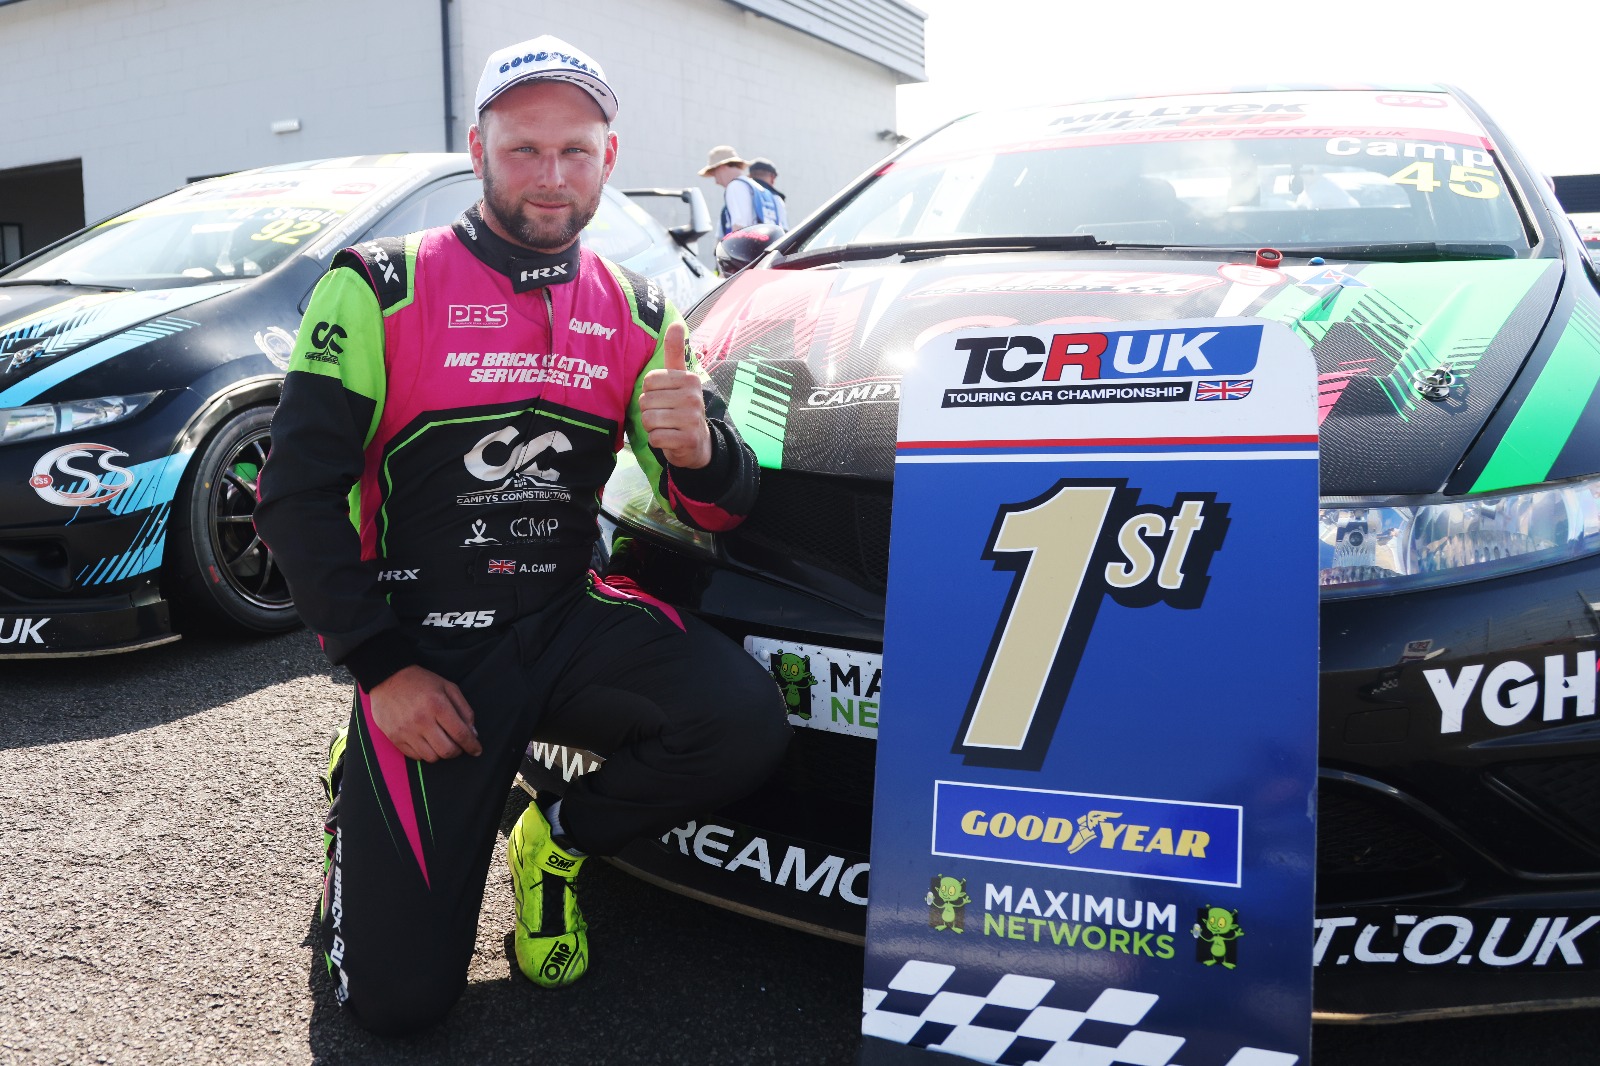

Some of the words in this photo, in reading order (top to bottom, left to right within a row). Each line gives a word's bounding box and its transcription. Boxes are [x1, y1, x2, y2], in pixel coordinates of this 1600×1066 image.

[1325, 137, 1494, 168] Camp
[1387, 161, 1500, 199] 45
[250, 218, 321, 245] 92
[520, 262, 568, 283] HRX
[569, 317, 617, 341] CAMPY
[444, 353, 480, 367] MC
[482, 353, 540, 367] BRICK
[955, 332, 1109, 384] TCR
[1113, 331, 1214, 374] UK
[948, 391, 1016, 403] TOURING
[1020, 390, 1053, 401] CAR
[1057, 386, 1184, 400] CHAMPIONSHIP
[457, 494, 498, 504] CAMPYS
[378, 568, 420, 582] HRX
[422, 610, 496, 628] AC45
[962, 487, 1205, 750] 1st
[961, 809, 1211, 859] GOODYEAR
[547, 853, 576, 870] OMP
[985, 883, 1177, 933] MAXIMUM
[983, 913, 1175, 960] NETWORKS
[544, 942, 571, 981] OMP
